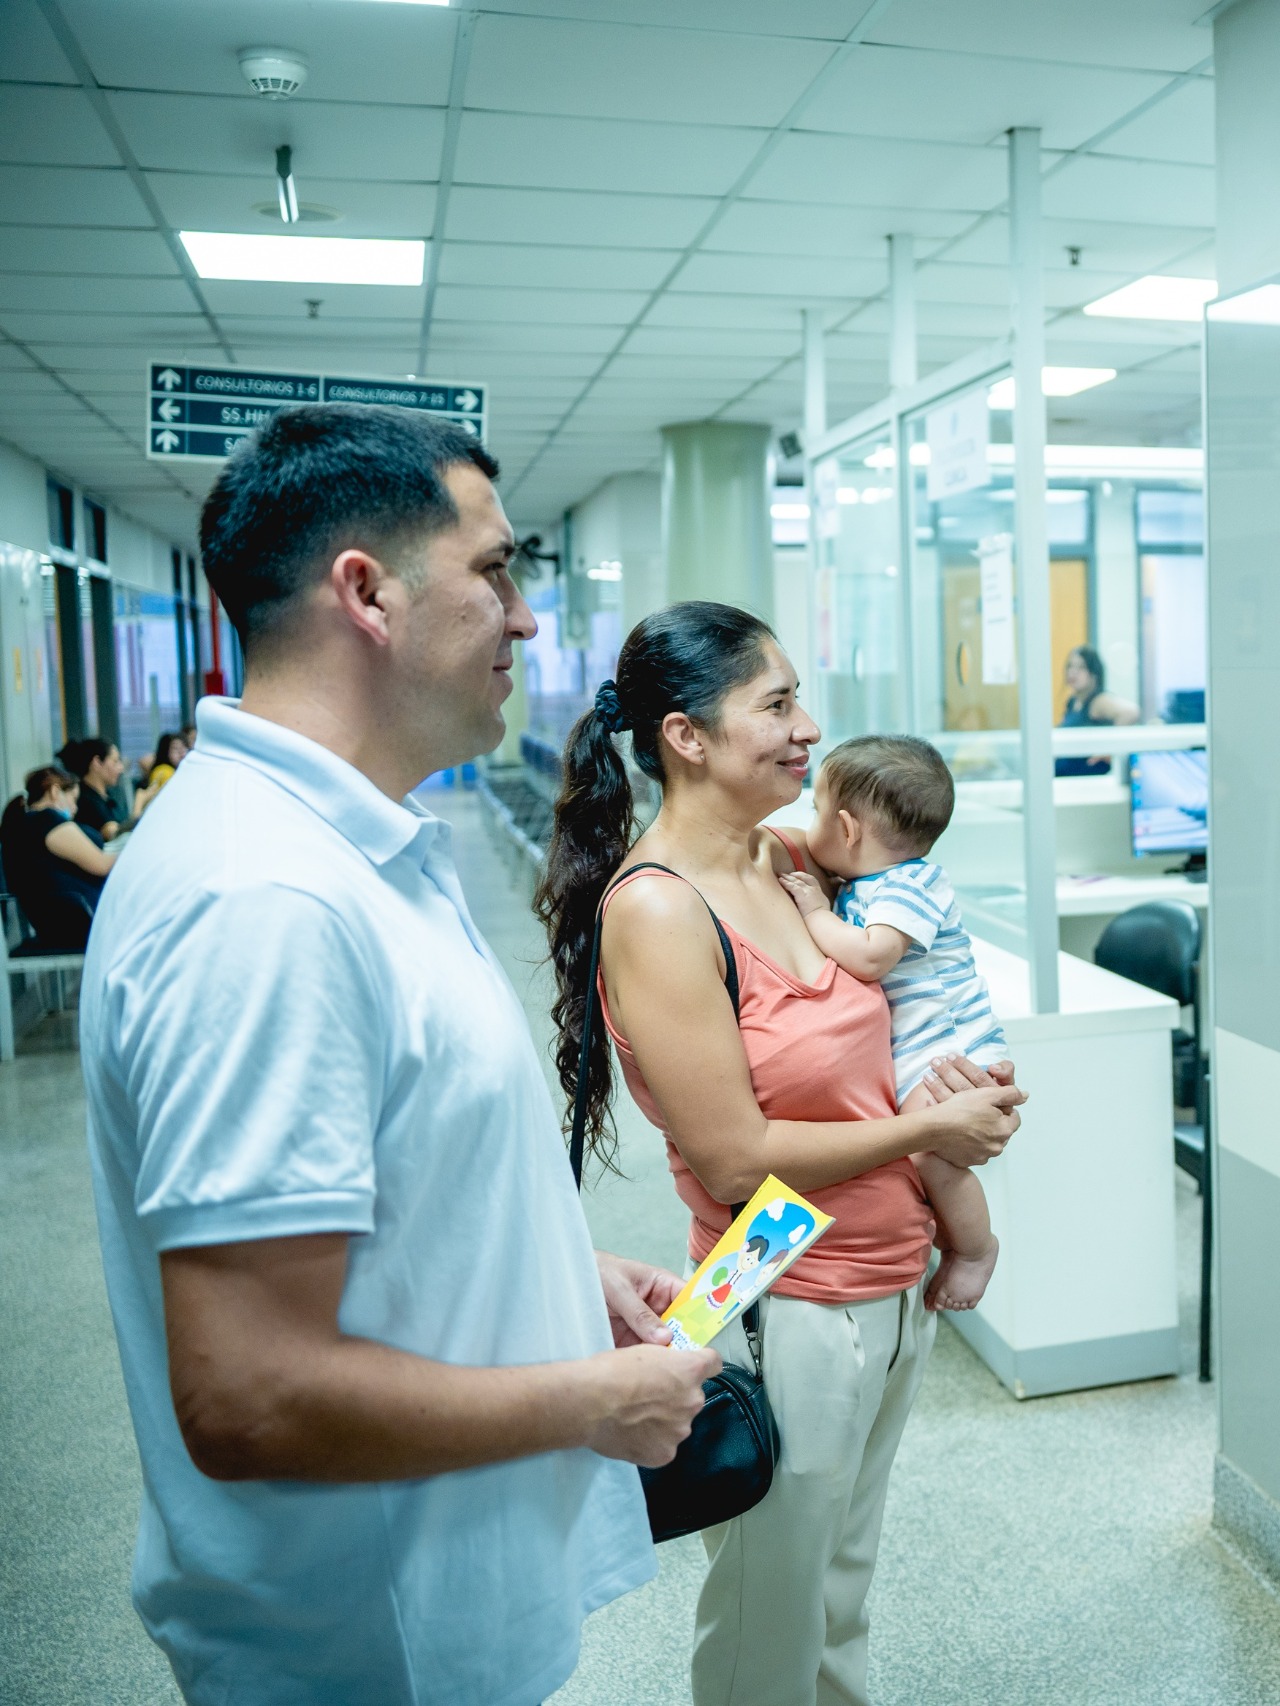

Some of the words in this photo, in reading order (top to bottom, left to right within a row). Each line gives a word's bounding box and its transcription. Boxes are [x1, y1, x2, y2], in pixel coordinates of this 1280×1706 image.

[195, 375, 295, 397] CONSULTORIOS
[297, 382, 318, 398] 1-6
[329, 385, 418, 405] CONSULTORIOS
